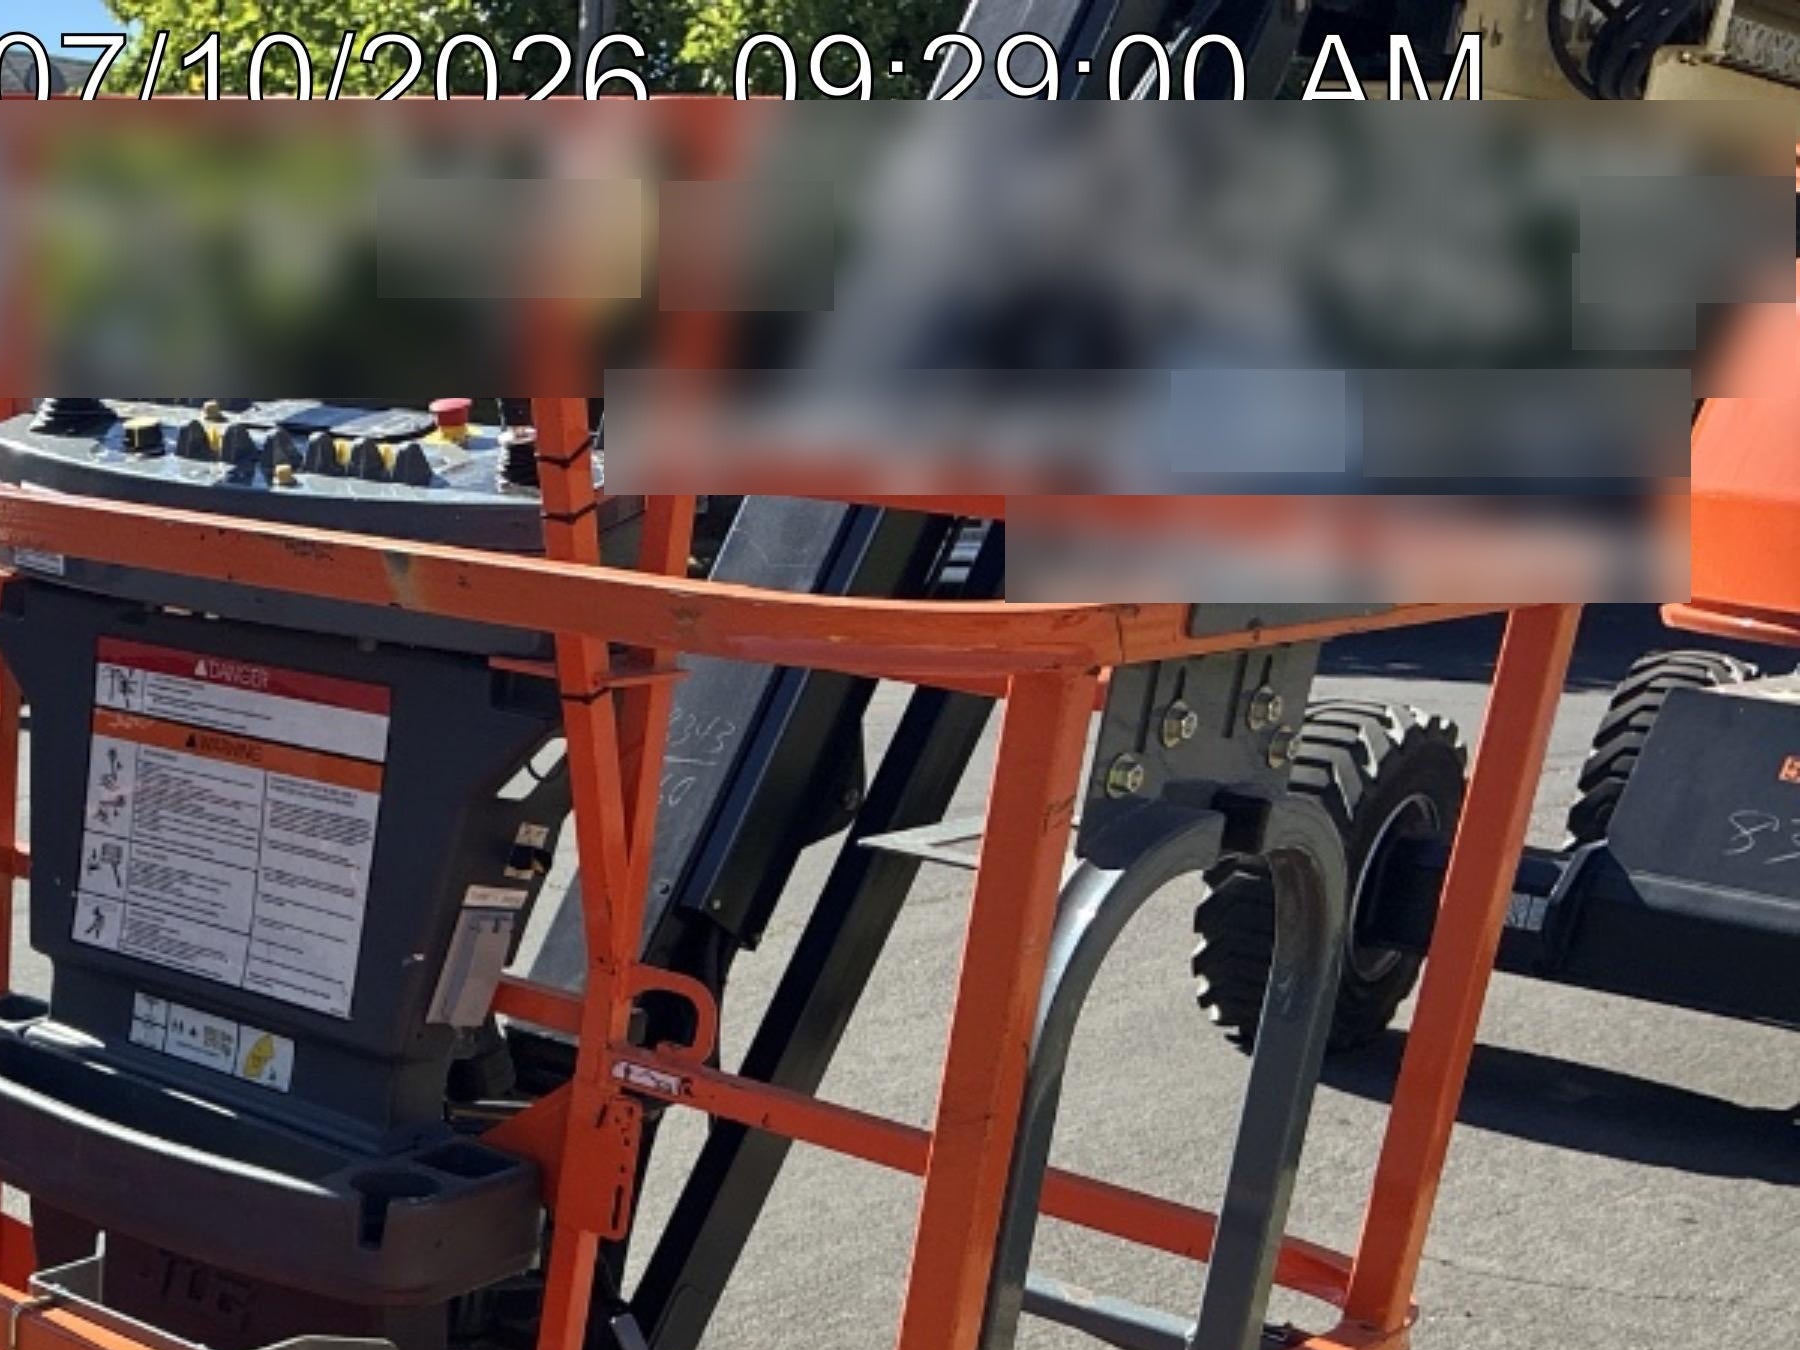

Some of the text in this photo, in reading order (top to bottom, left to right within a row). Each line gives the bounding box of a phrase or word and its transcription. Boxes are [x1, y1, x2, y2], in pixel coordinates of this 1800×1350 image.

[209, 660, 269, 689] DANGER
[201, 731, 263, 762] WARNING
[1721, 809, 1800, 857] 8
